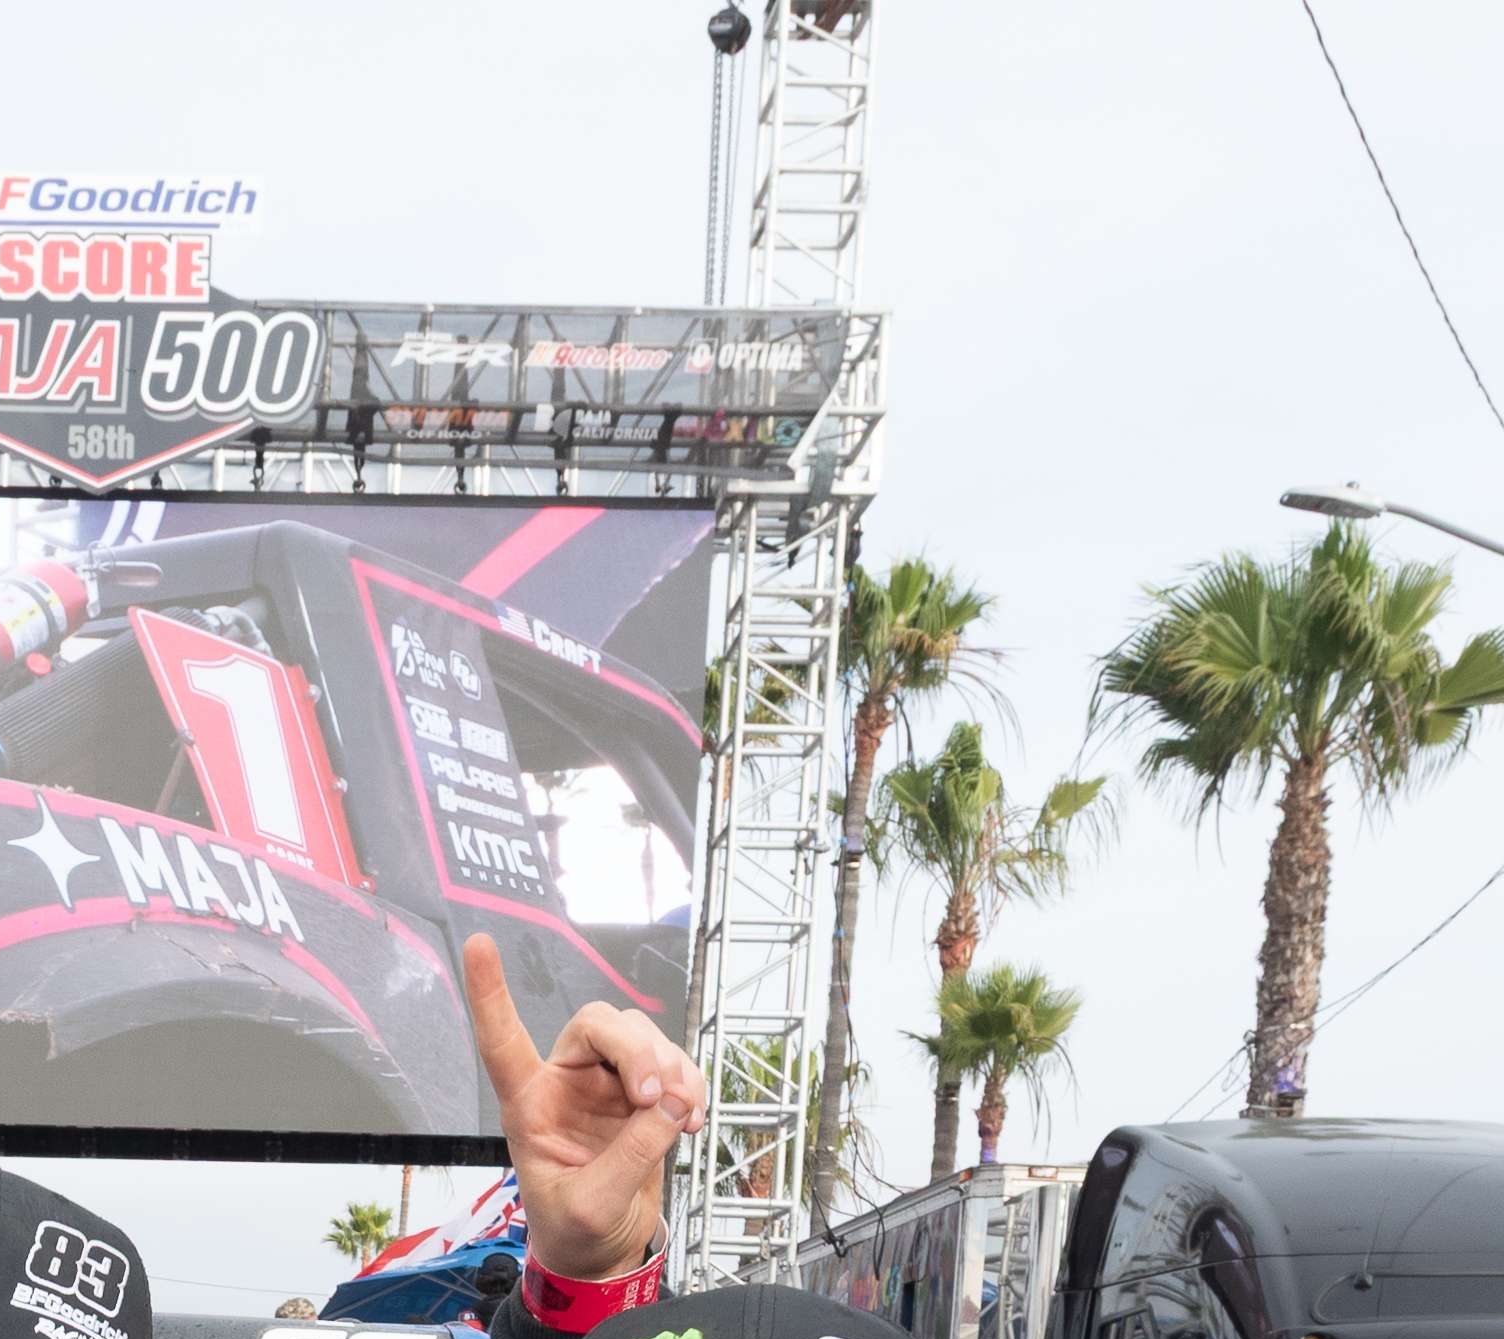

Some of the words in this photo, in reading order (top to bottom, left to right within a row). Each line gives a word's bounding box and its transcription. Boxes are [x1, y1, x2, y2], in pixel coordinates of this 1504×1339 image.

[140, 310, 320, 414] 500
[67, 424, 136, 460] 58th
[532, 618, 602, 675] CRAFT
[184, 653, 307, 852] 1
[426, 751, 519, 800] POLARIS
[98, 815, 306, 944] MAJA
[447, 820, 540, 881] KMC
[25, 1219, 131, 1319] 83
